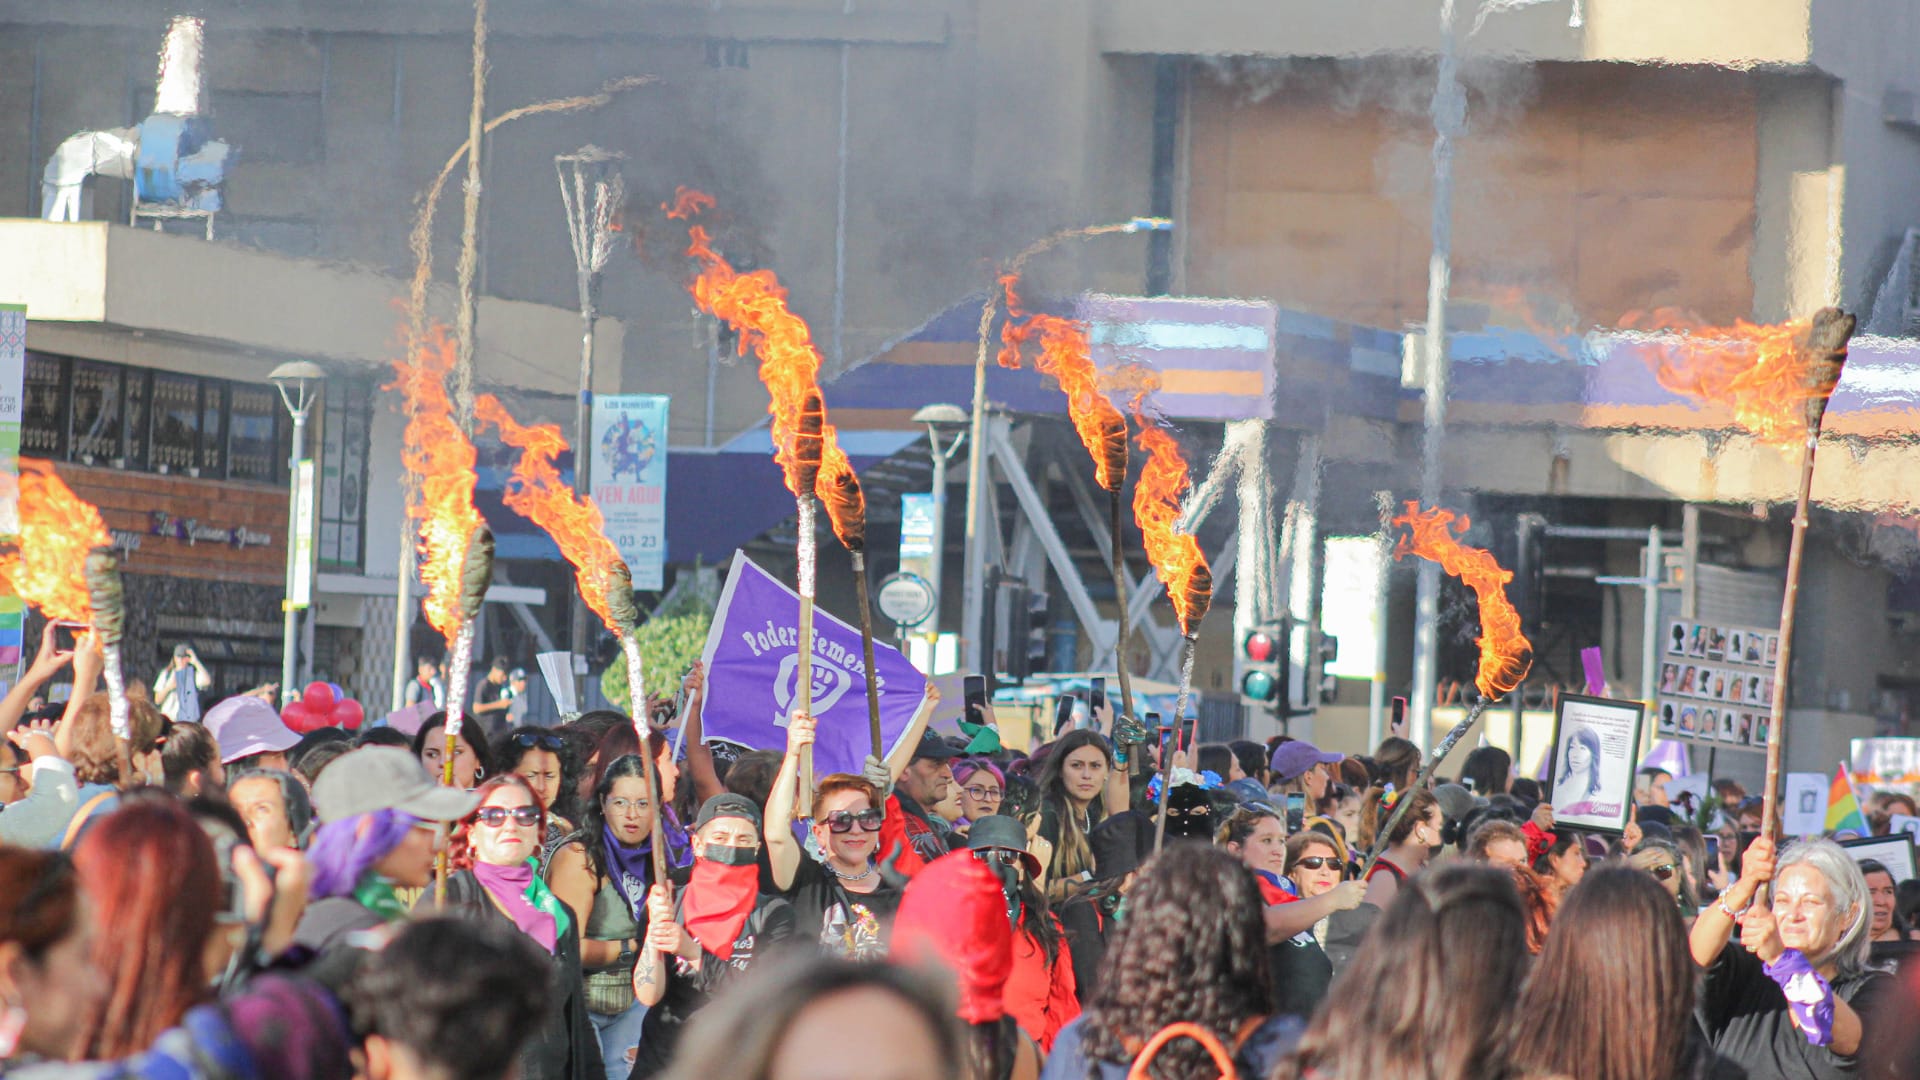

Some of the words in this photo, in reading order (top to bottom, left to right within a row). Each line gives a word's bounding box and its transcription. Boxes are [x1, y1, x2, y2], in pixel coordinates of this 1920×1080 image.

[594, 485, 623, 505] VEN
[641, 535, 657, 548] 23
[742, 620, 797, 657] Poder
